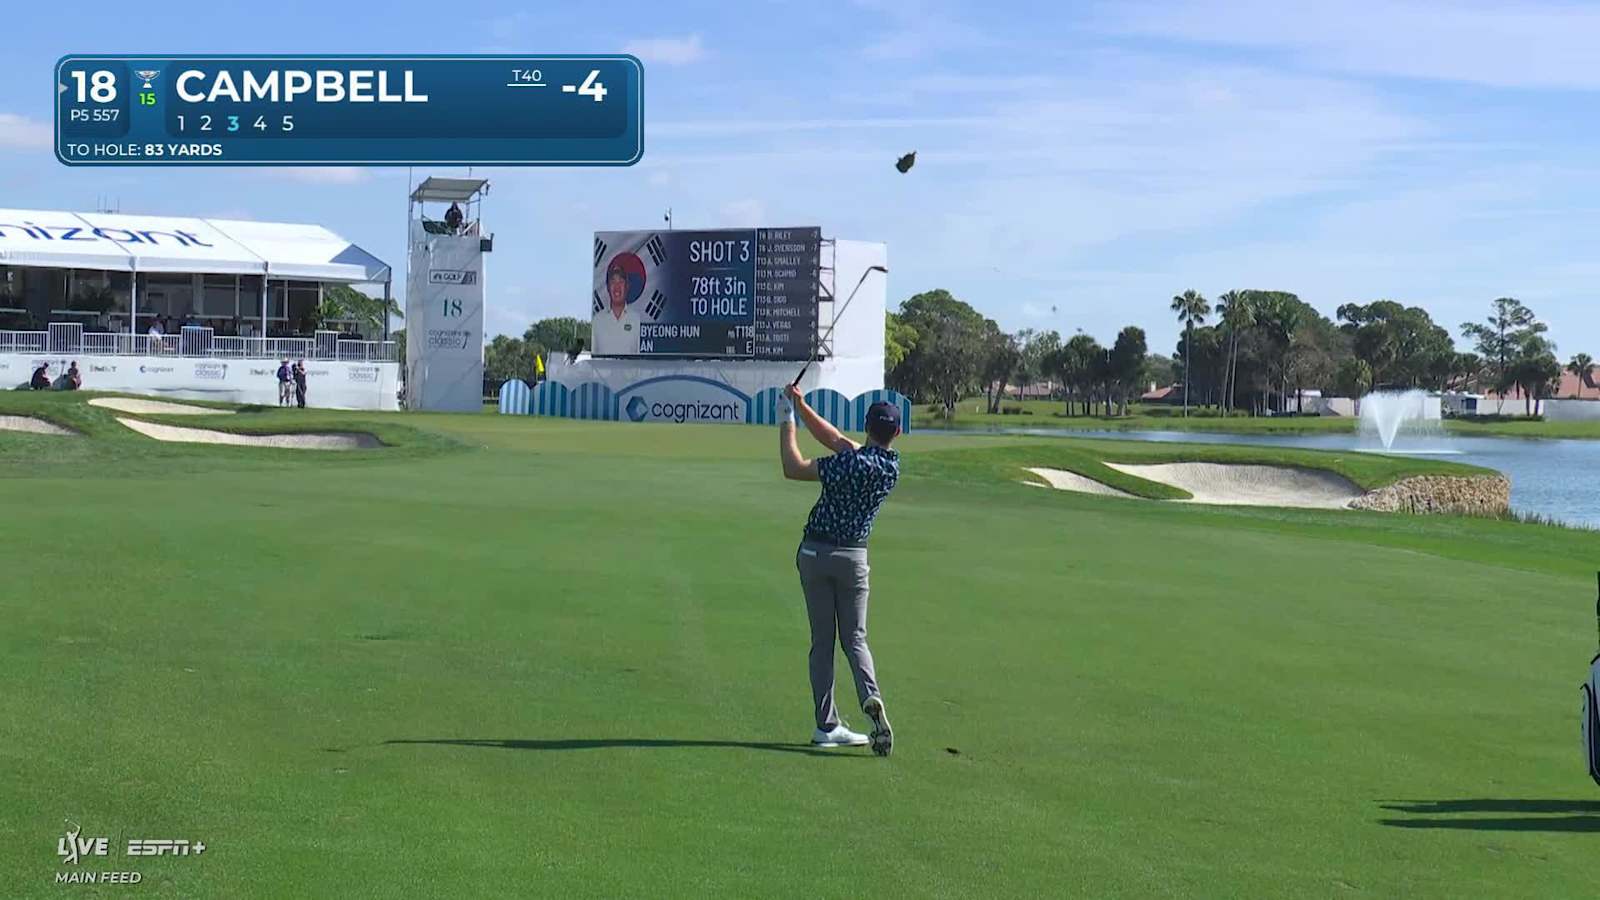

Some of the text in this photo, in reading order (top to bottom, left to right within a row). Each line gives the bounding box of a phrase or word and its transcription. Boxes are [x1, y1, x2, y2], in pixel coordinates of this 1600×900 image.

[689, 240, 750, 262] SHOT 3
[691, 276, 746, 295] 78ft 3in
[443, 298, 463, 317] 18
[690, 298, 748, 315] TO HOLE
[640, 325, 700, 337] BYEONG HUN
[640, 340, 654, 352] AN
[746, 341, 753, 353] E
[651, 400, 739, 424] cognizant
